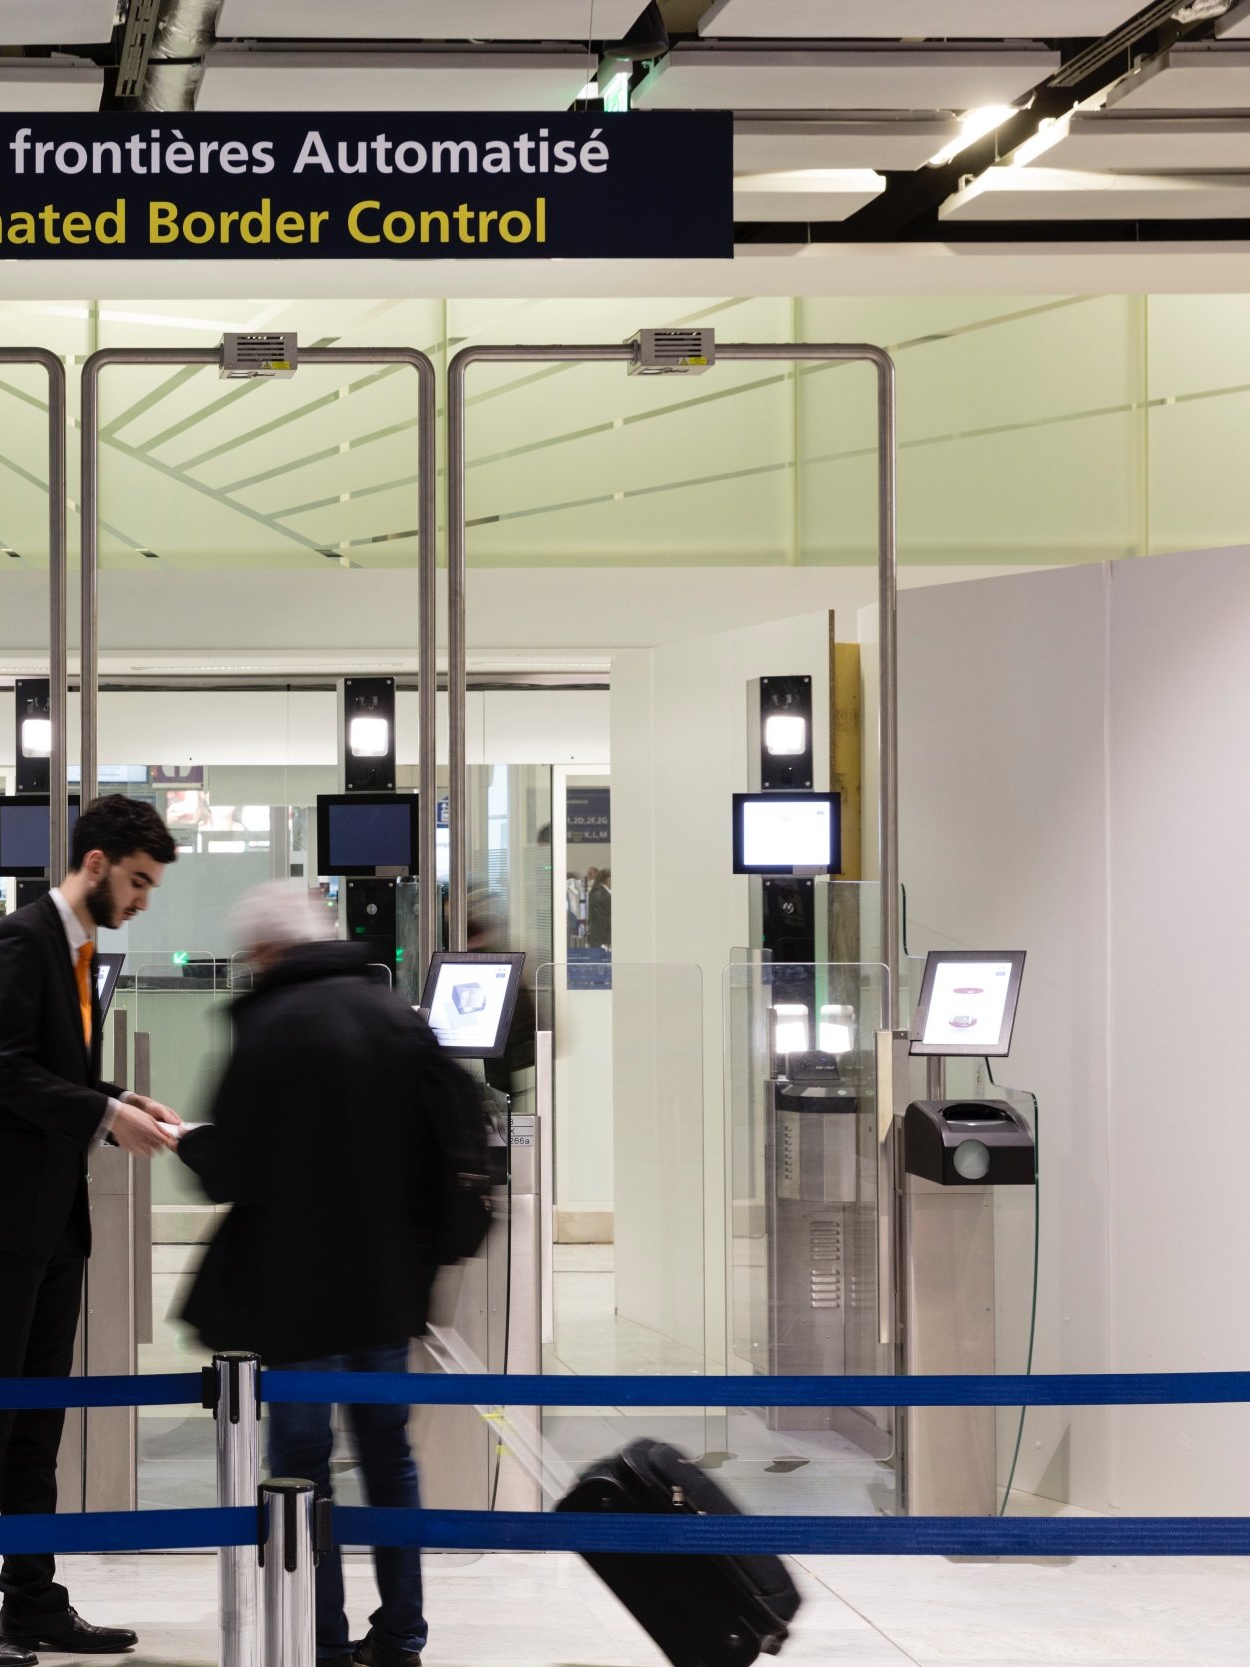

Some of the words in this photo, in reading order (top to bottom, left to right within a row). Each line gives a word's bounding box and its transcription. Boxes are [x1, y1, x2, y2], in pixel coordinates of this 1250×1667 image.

[9, 127, 275, 175] frontières
[292, 128, 610, 175] Automatisé
[149, 197, 330, 244] Border
[347, 197, 546, 244] Control
